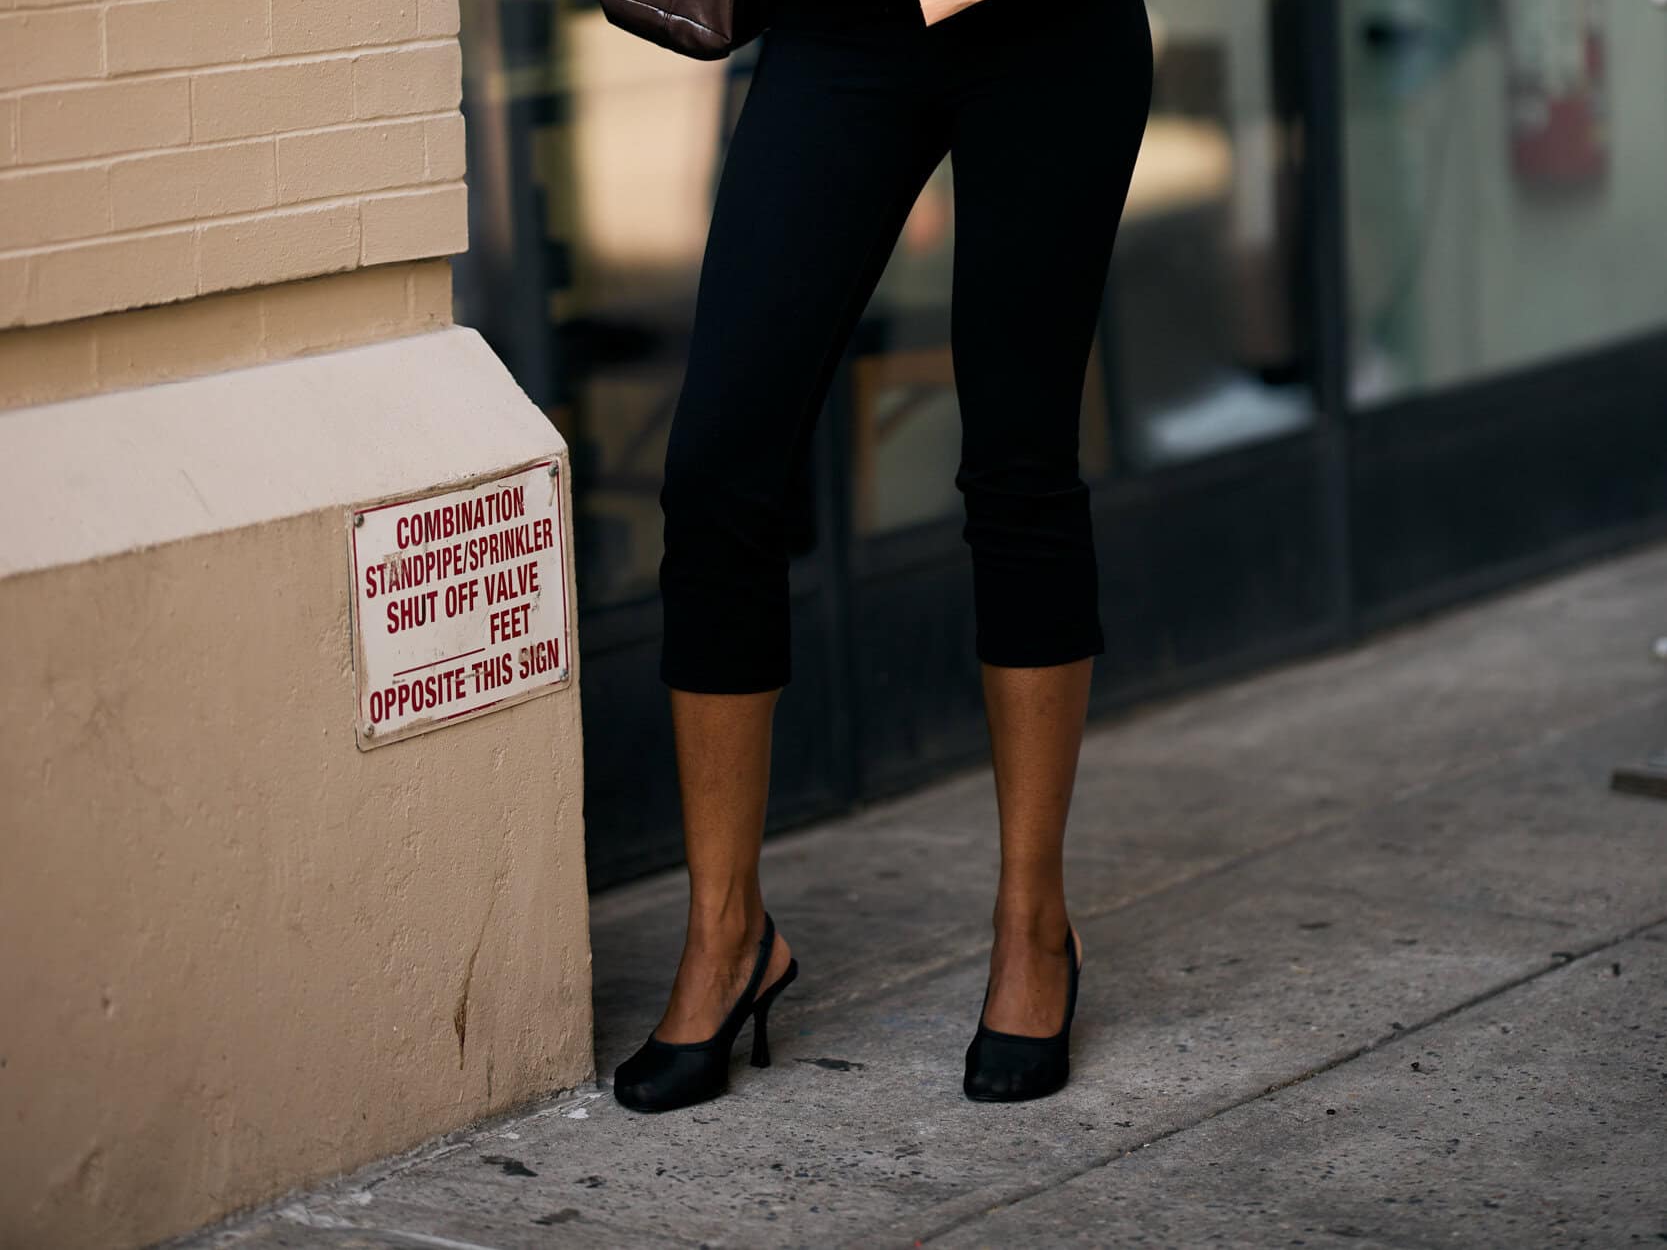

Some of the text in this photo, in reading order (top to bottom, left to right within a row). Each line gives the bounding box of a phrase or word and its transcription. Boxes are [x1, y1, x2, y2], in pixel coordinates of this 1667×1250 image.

[396, 485, 525, 549] COMBINATION
[366, 518, 554, 598] STANDPIPE/SPRINKLER
[387, 561, 539, 634] SHUT OFF VALVE
[490, 603, 531, 644] FEET
[370, 638, 559, 724] OPPOSITE THIS SIGN
